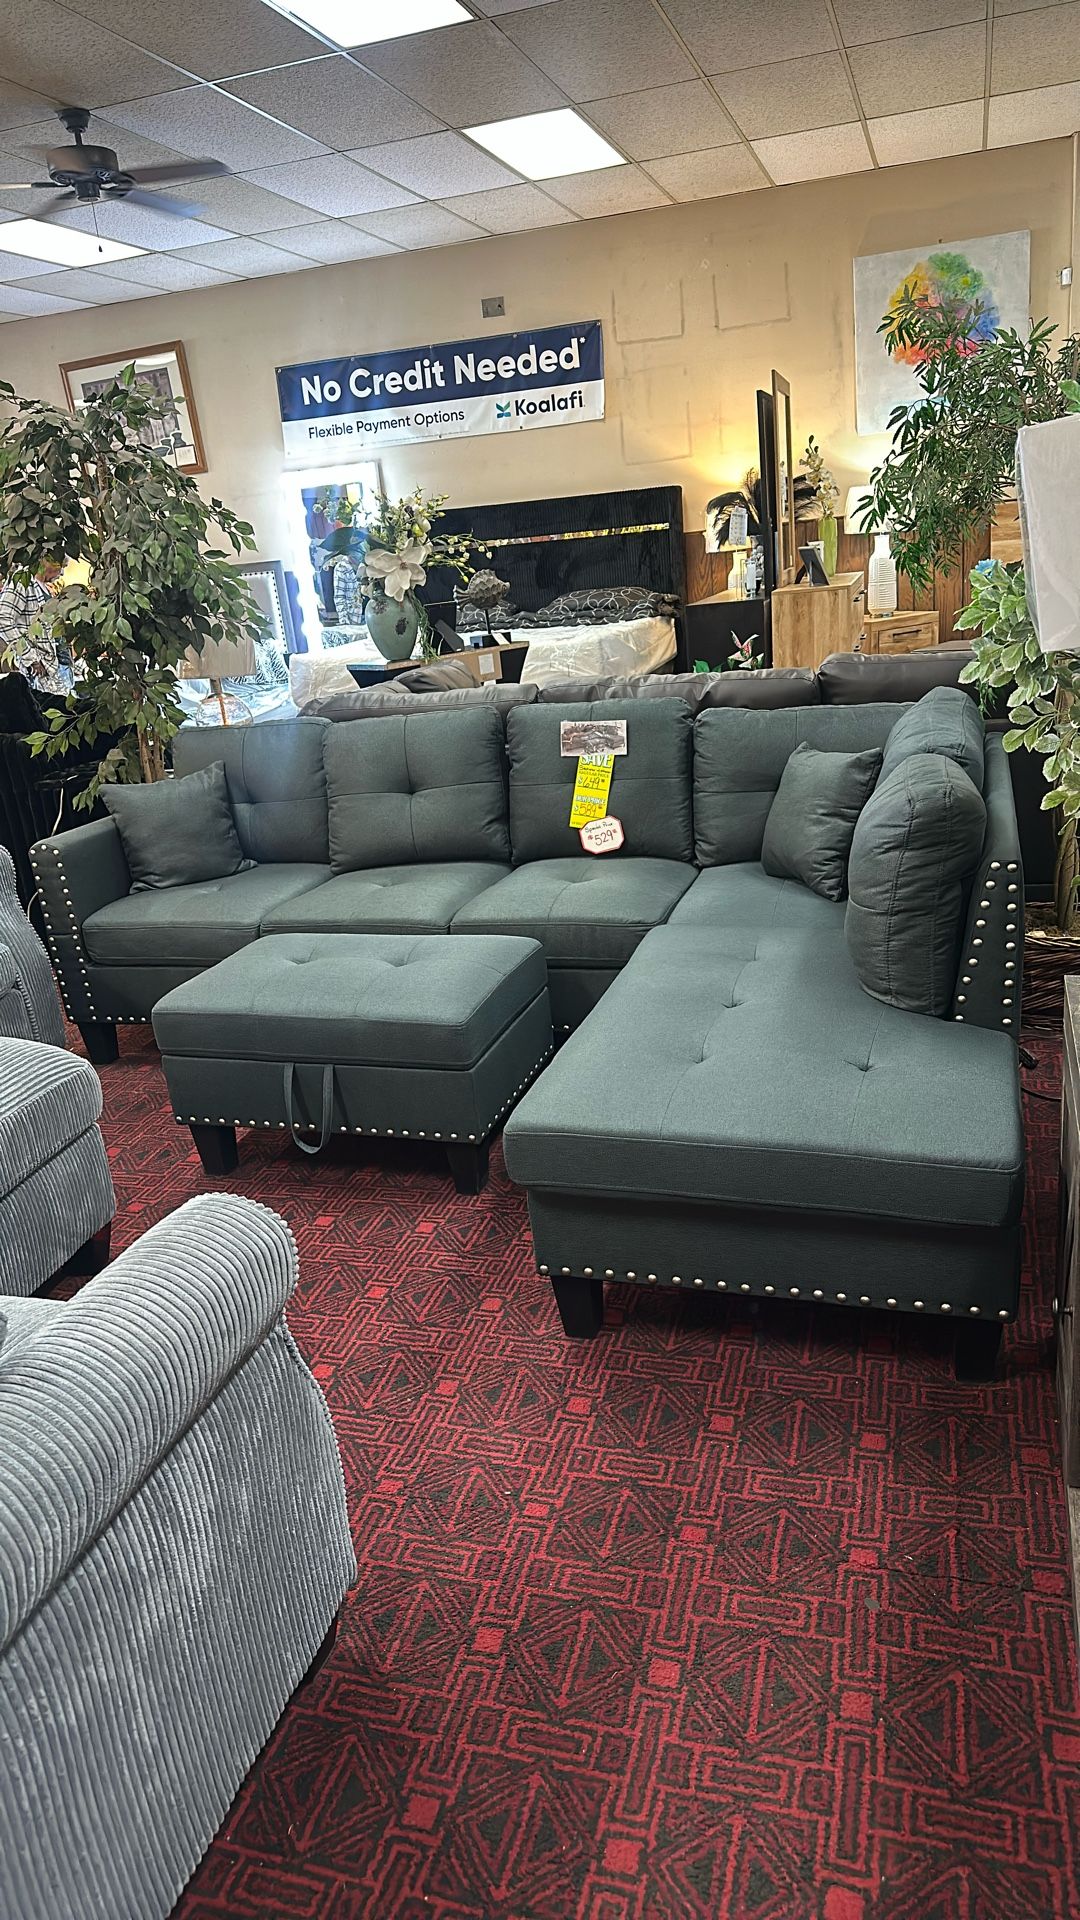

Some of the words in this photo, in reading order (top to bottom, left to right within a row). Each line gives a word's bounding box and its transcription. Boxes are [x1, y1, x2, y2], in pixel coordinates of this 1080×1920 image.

[301, 374, 342, 406] No
[349, 358, 446, 397] Credit
[514, 390, 586, 416] Koalafi
[308, 422, 354, 439] Flexible
[357, 415, 412, 434] Payment
[414, 409, 465, 427] Options
[580, 754, 612, 768] SAVE
